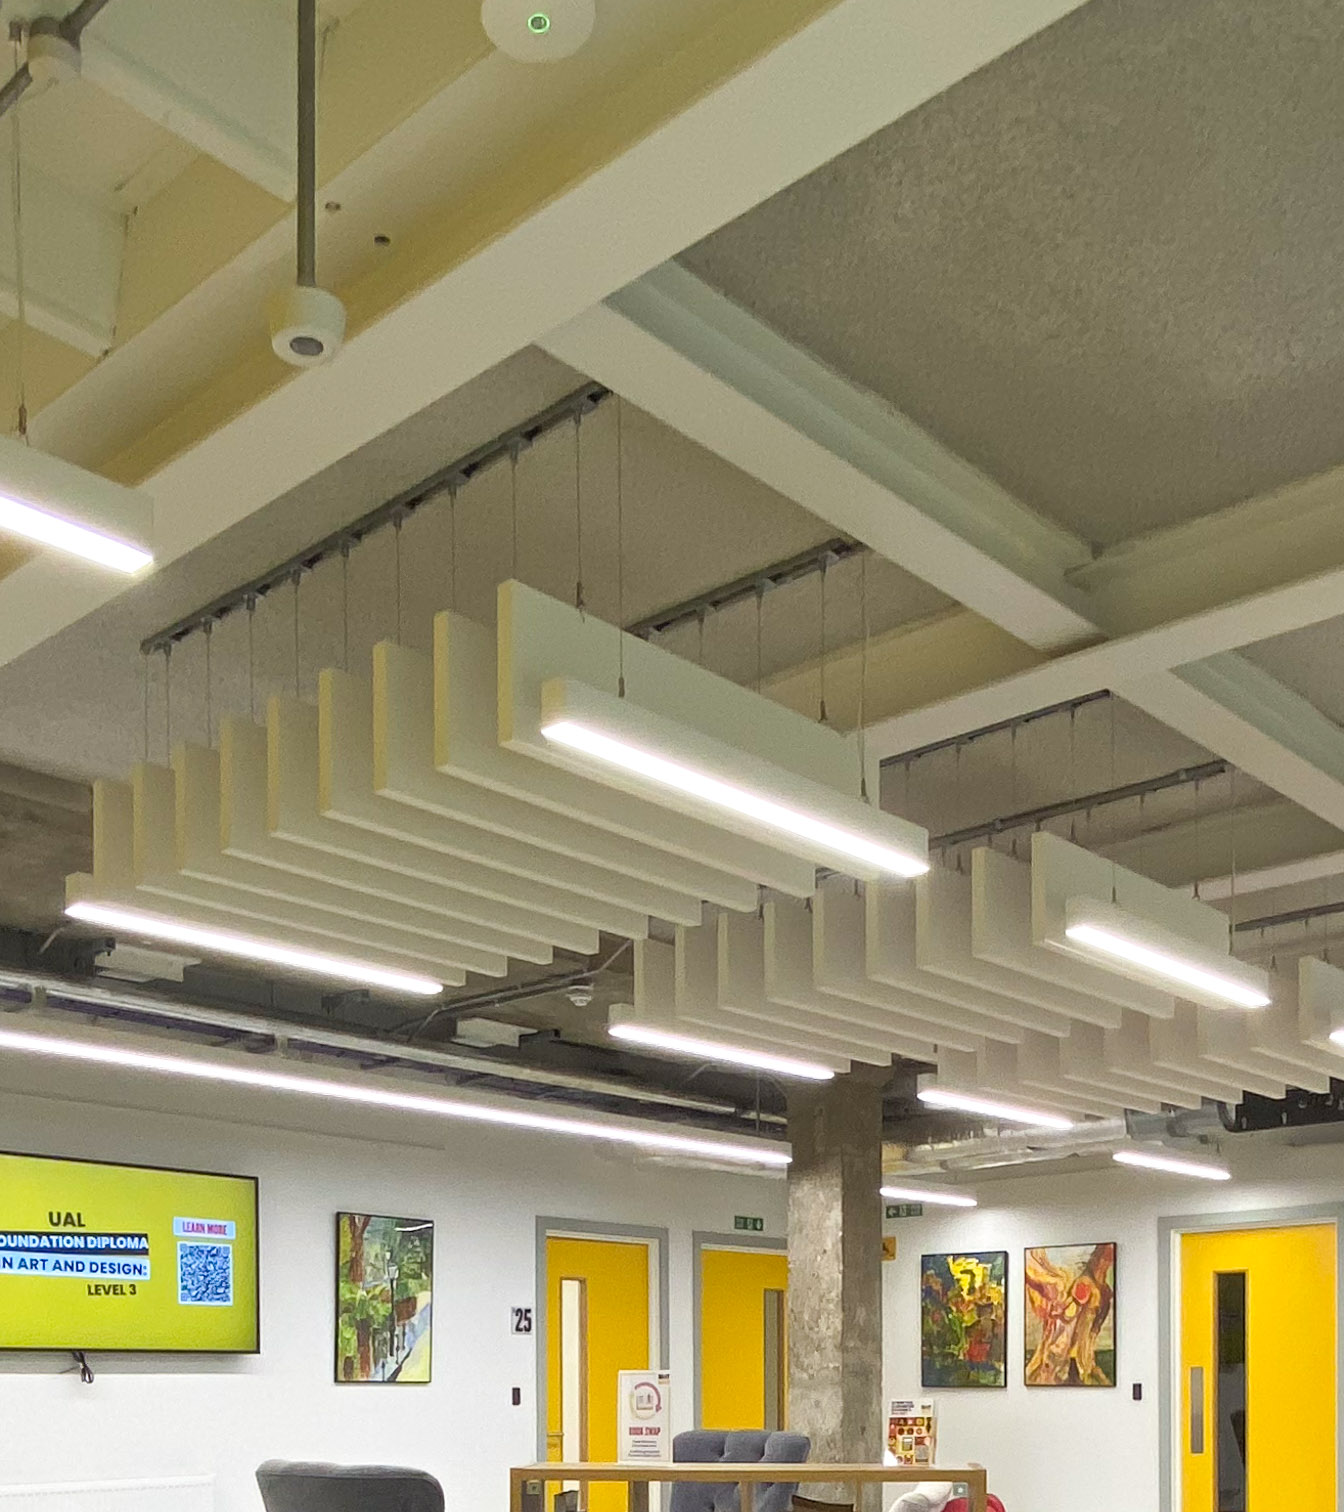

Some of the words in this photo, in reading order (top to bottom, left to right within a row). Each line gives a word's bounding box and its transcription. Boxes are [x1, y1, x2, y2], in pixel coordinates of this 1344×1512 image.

[48, 1211, 86, 1227] UAL
[182, 1221, 205, 1234] LEARN
[87, 1236, 149, 1249] DIPLOMA
[17, 1257, 49, 1271] ART
[52, 1260, 85, 1273] AND
[89, 1262, 148, 1276] DESIGN:
[87, 1284, 126, 1296] LEVEL
[129, 1284, 137, 1296] 3
